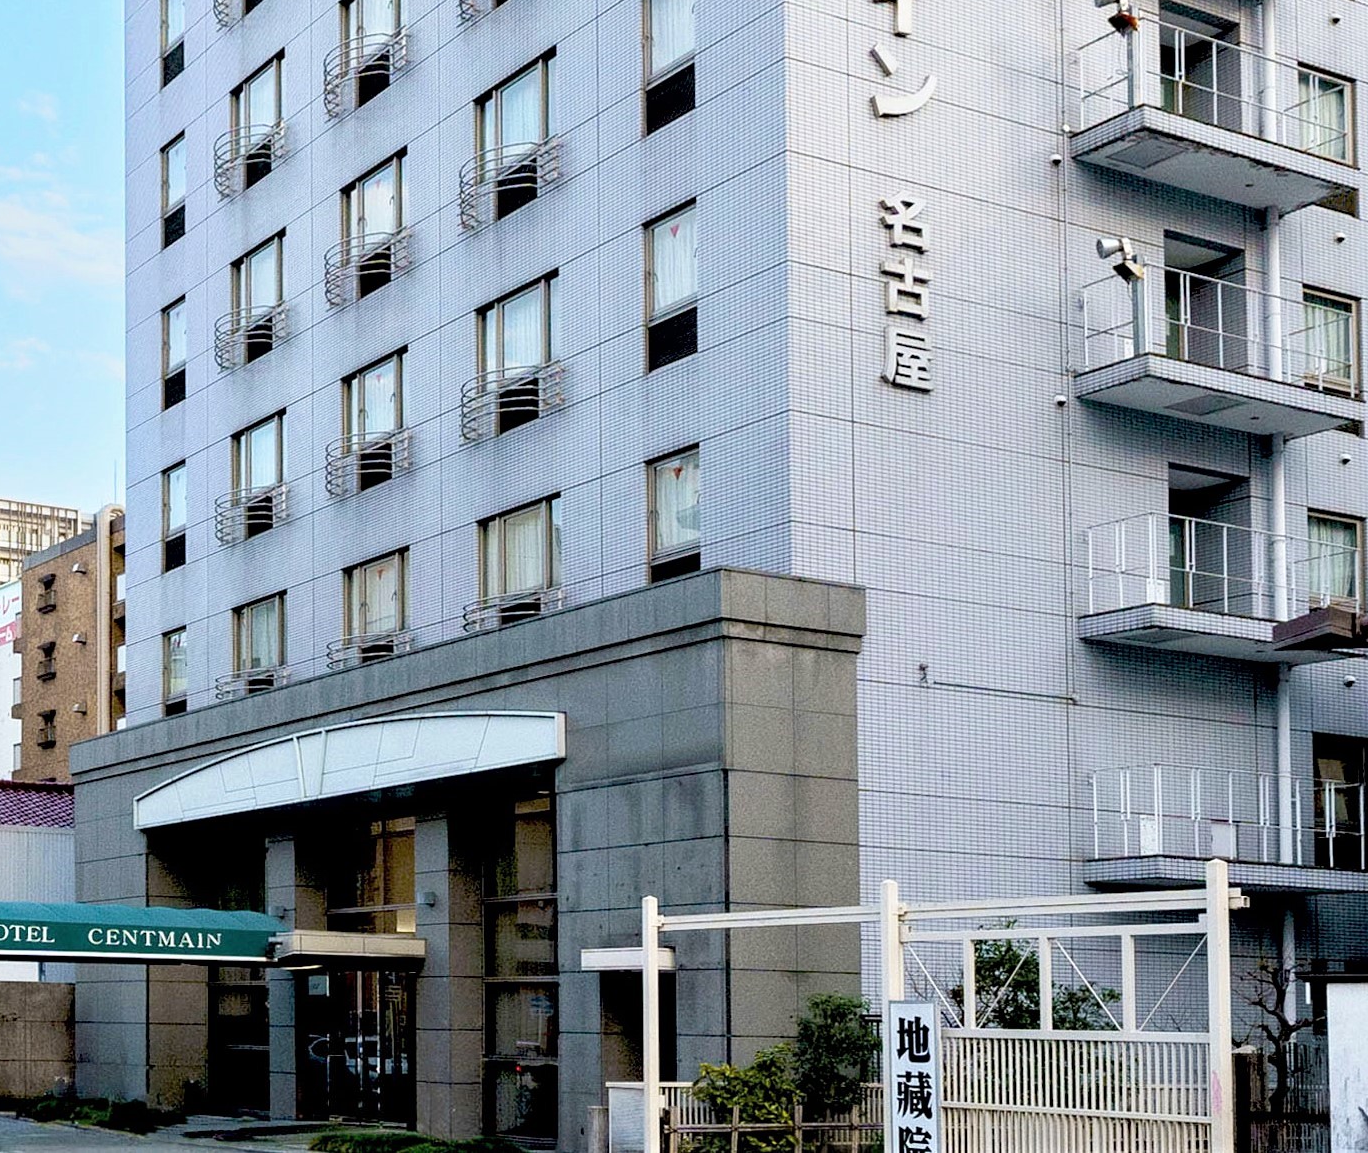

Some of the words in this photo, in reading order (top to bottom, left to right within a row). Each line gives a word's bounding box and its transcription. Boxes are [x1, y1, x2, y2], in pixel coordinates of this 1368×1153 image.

[880, 189, 933, 392] 名古屋
[88, 928, 222, 949] CENTMAIN
